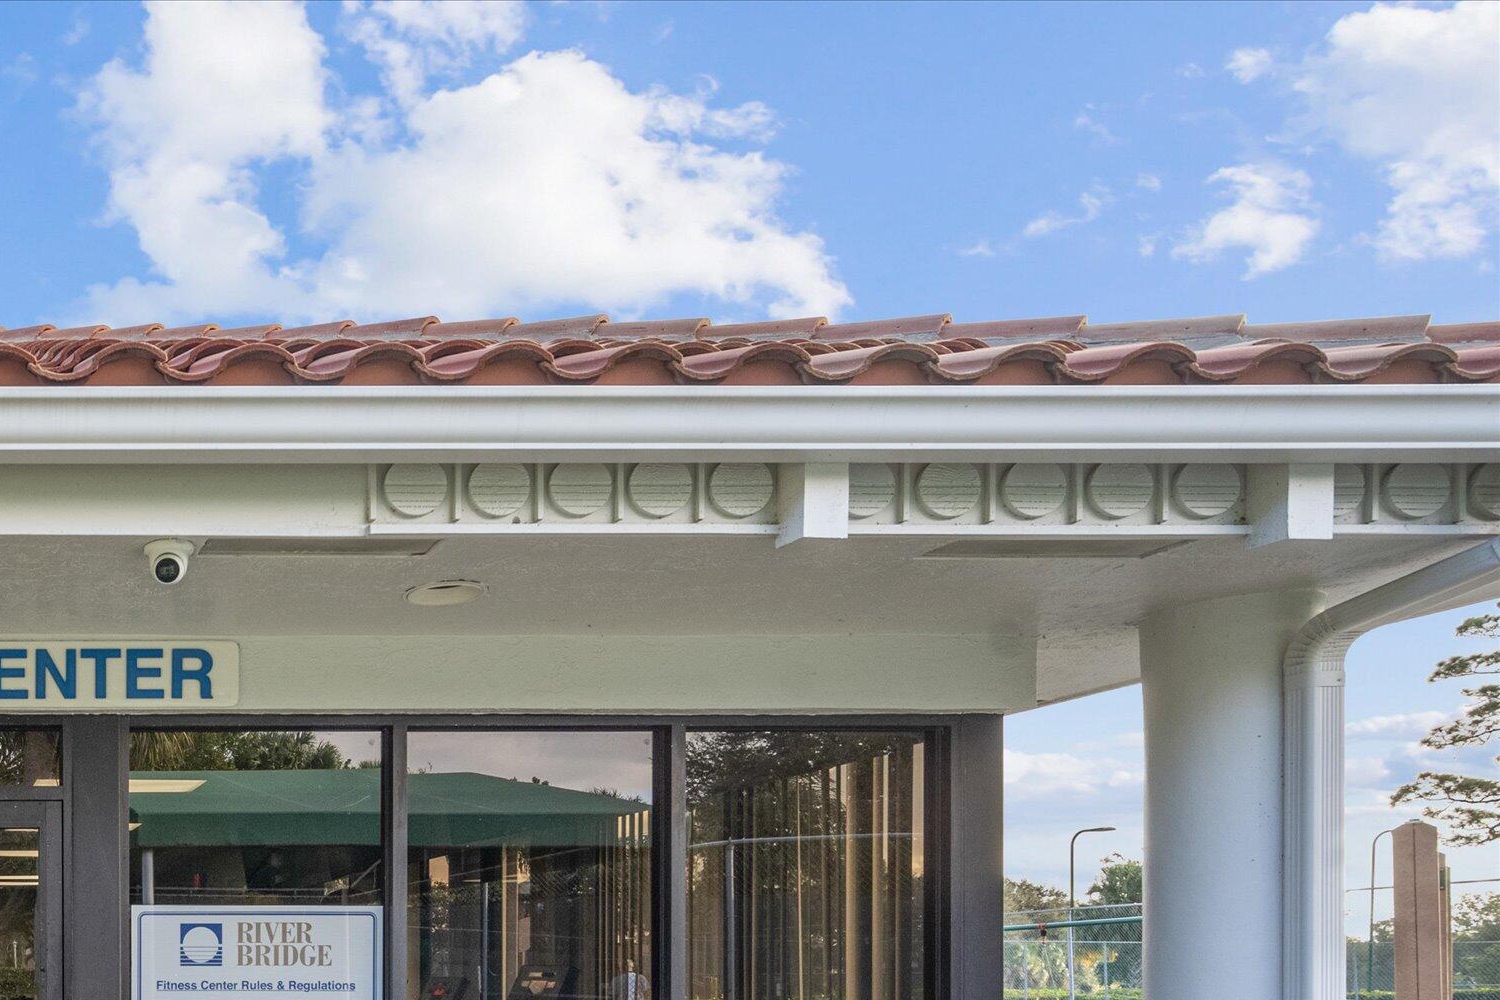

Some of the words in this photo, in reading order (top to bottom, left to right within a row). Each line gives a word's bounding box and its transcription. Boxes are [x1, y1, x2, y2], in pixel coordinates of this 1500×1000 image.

[238, 922, 312, 944] RIVER
[238, 945, 332, 966] BRIDGE
[157, 981, 197, 990] Fitness
[201, 981, 238, 990] Center
[242, 981, 273, 990] Rules
[277, 981, 285, 990] &
[289, 981, 356, 992] Regulations
